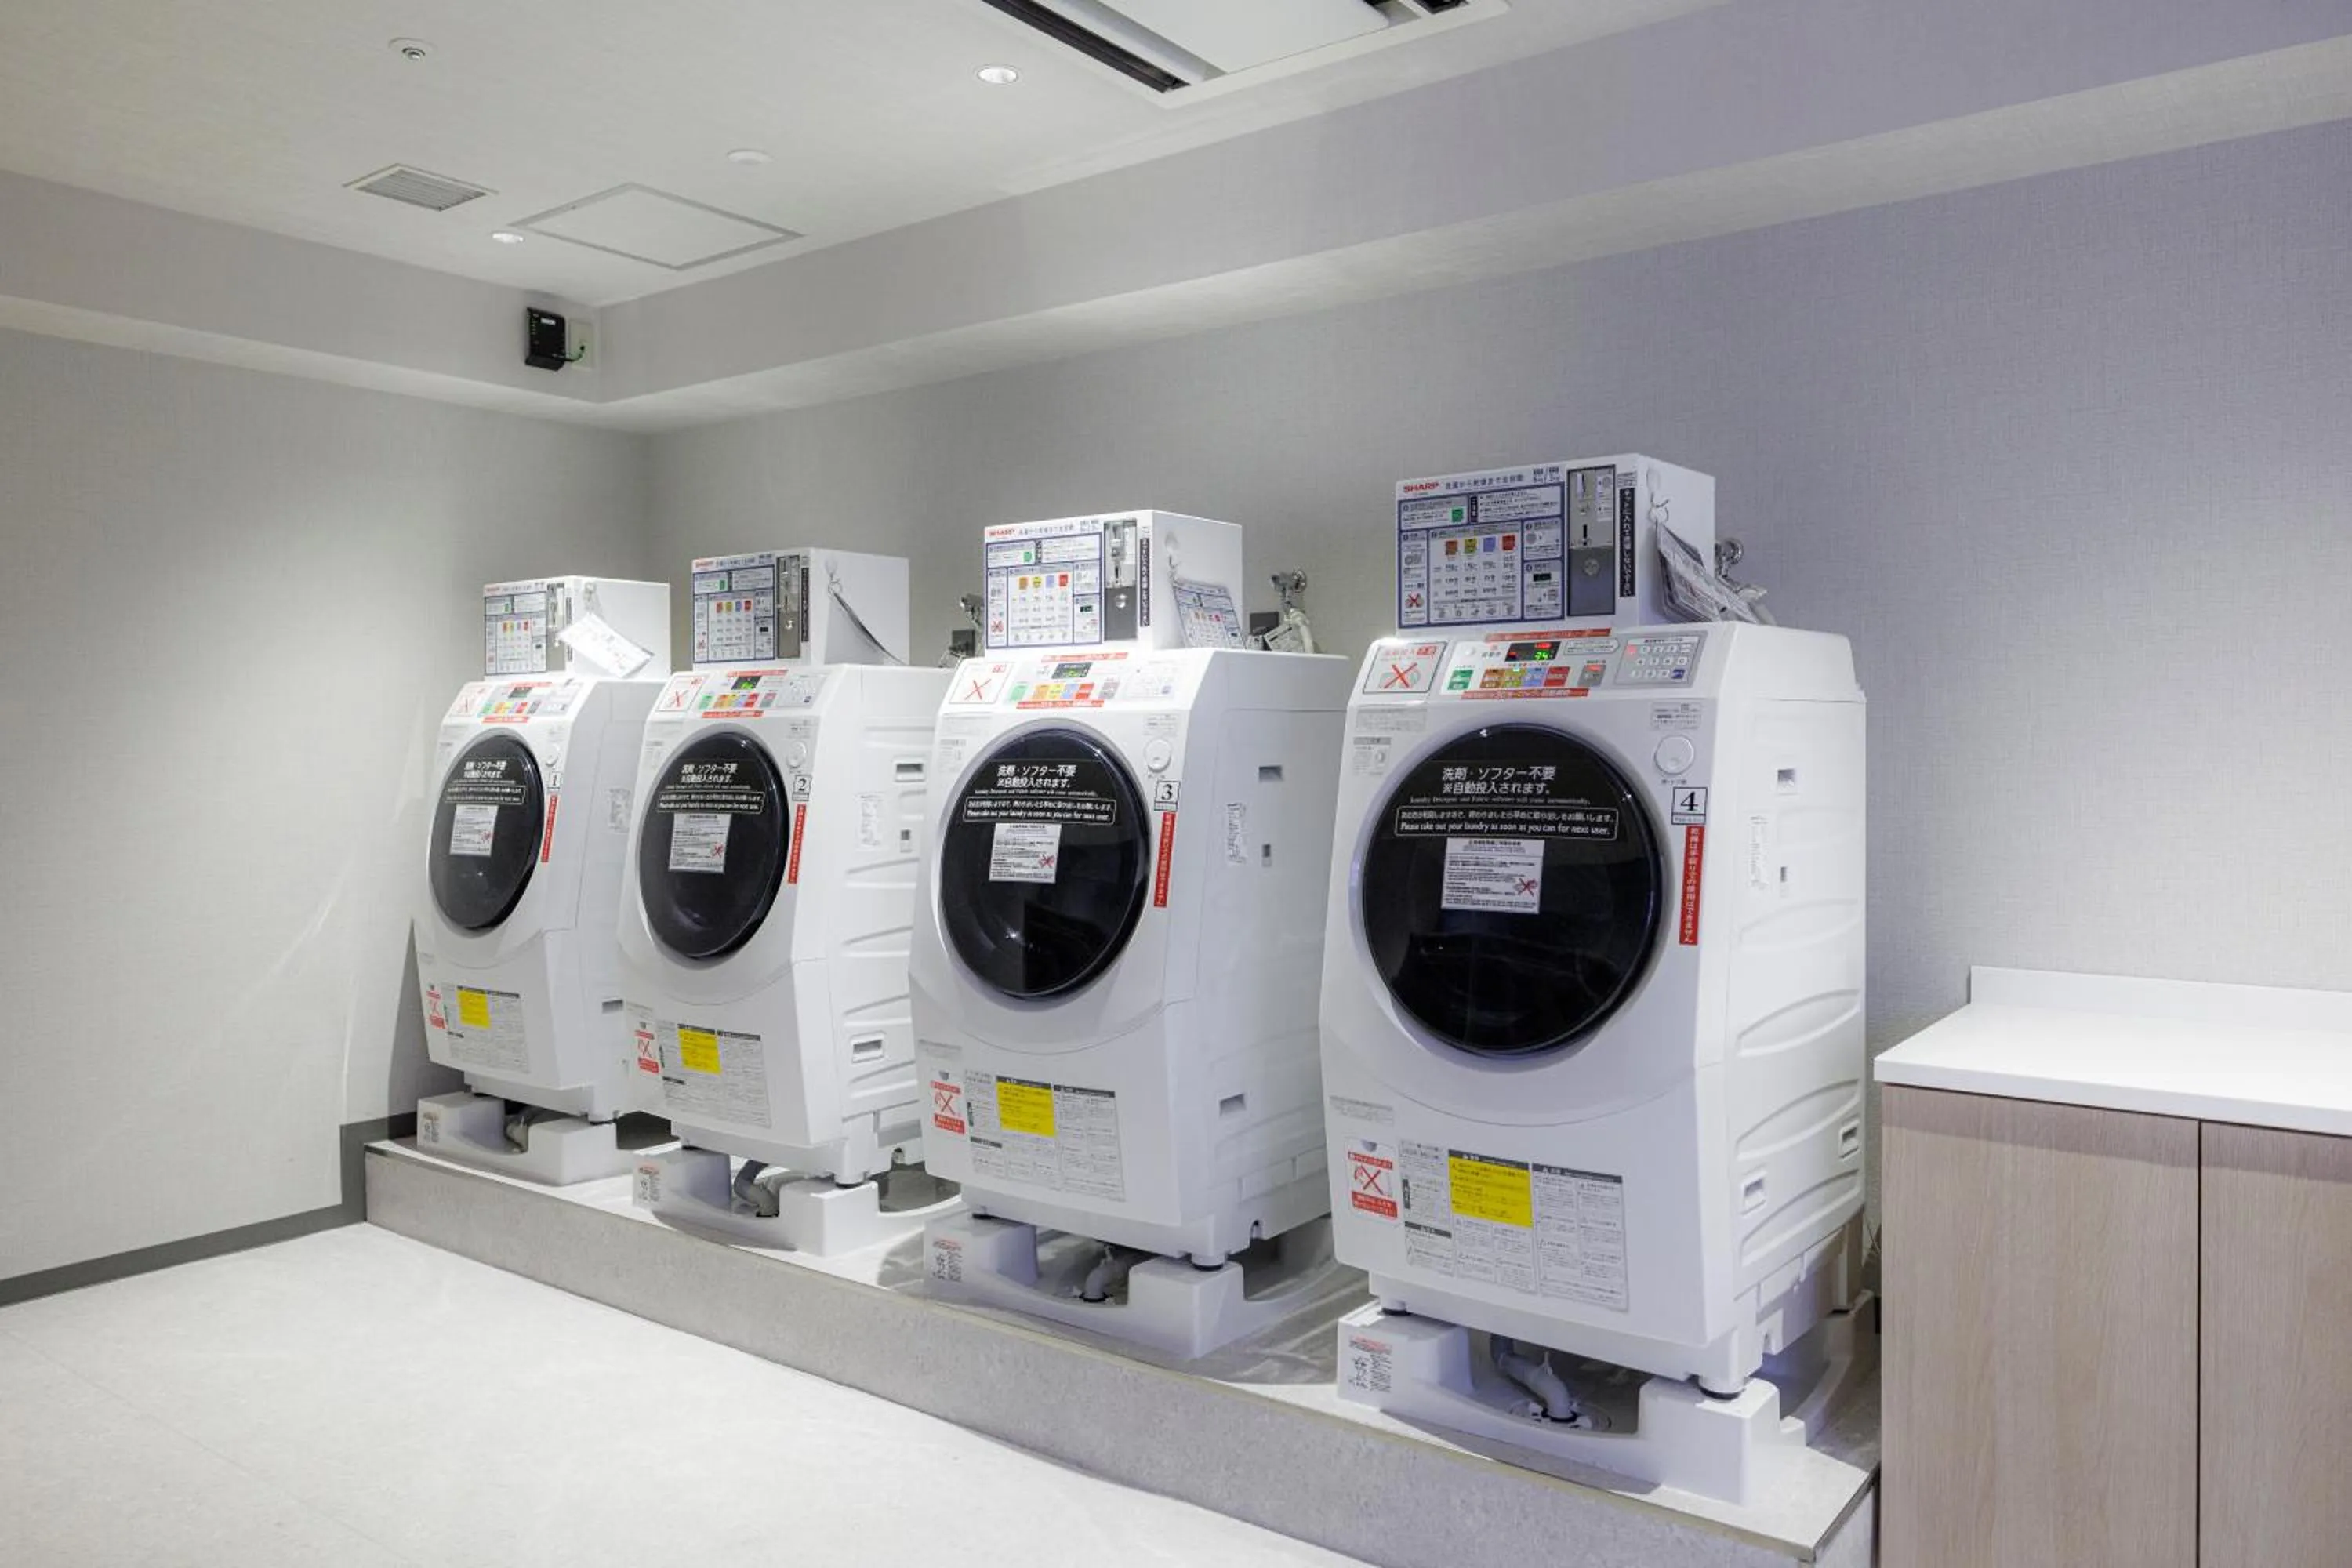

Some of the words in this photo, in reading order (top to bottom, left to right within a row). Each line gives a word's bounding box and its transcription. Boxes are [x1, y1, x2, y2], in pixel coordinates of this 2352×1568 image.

[1403, 481, 1439, 493] SHARP
[1443, 766, 1555, 780] 洗剤・ソフター不要
[798, 778, 806, 791] 2
[1161, 784, 1172, 800] 3
[1680, 791, 1699, 811] 4
